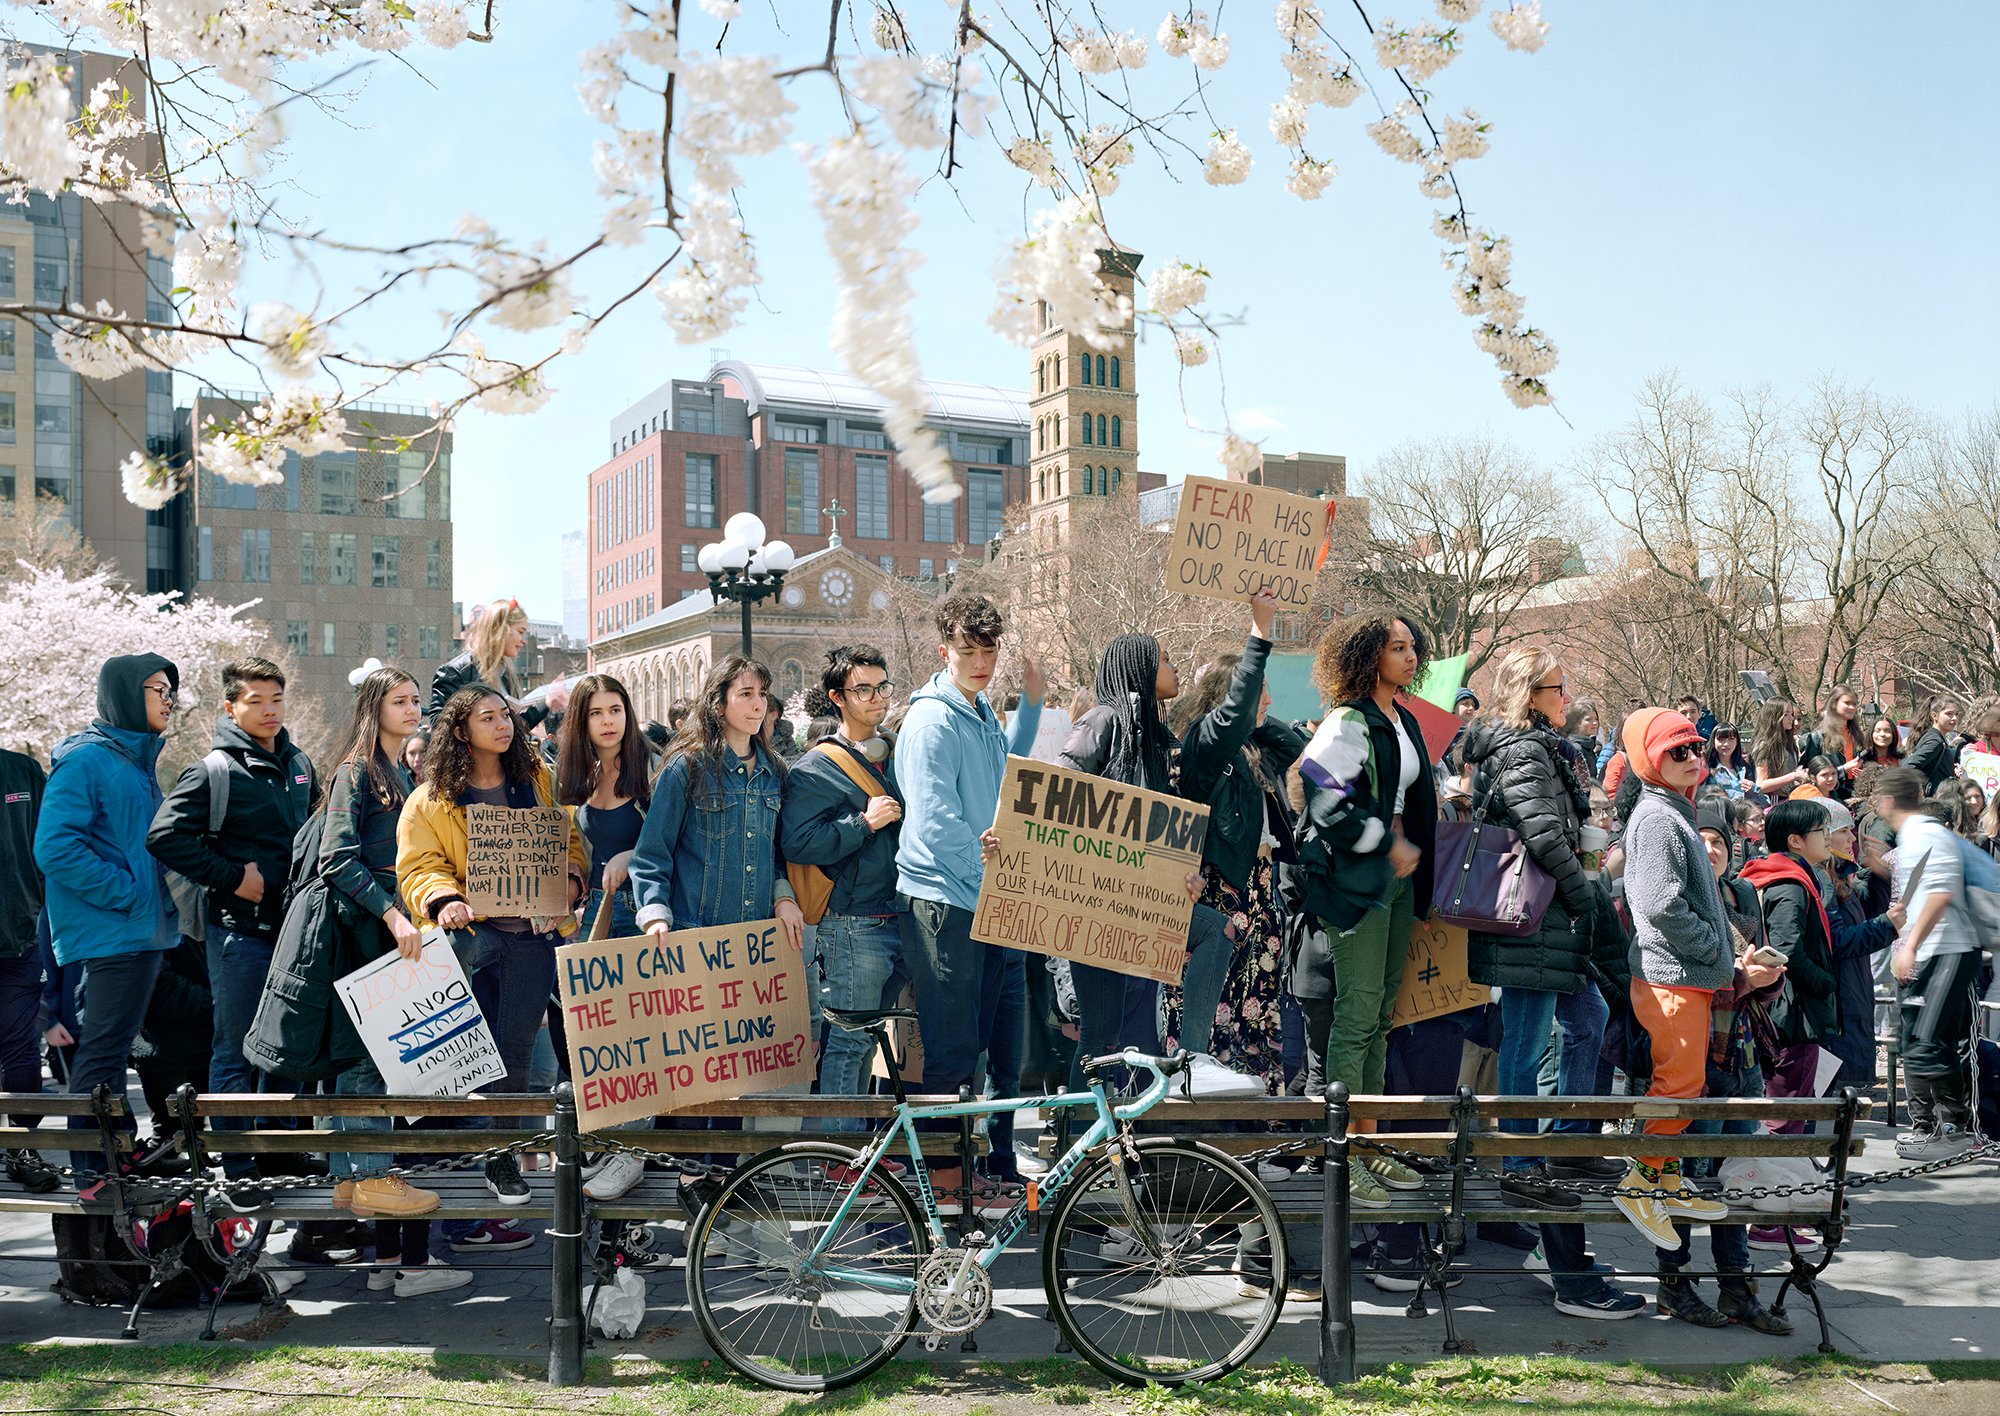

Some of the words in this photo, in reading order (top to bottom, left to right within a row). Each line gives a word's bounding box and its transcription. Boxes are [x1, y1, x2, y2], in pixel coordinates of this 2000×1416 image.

[1192, 484, 1254, 524] FEAR
[1274, 504, 1313, 536] HAS
[1187, 522, 1222, 550] NO
[1234, 531, 1289, 567] PLACE
[1295, 545, 1316, 571] IN
[1180, 558, 1223, 590] OUR
[1234, 569, 1312, 605] SCHOOLS
[472, 810, 517, 821] WHEN
[522, 811, 526, 821] I
[529, 810, 563, 822] SAID
[535, 823, 560, 836] DIE
[1013, 769, 1045, 816] I
[1043, 774, 1125, 834] HAVE
[1120, 796, 1142, 842] A
[517, 839, 529, 849] TO
[532, 837, 568, 853] MATH
[1024, 820, 1070, 848] THAT
[1073, 834, 1113, 859] ONE
[1116, 844, 1147, 869] DAY,
[468, 864, 510, 877] MEAN
[516, 865, 528, 876] IT
[531, 864, 560, 876] THIS
[999, 850, 1031, 875] WE
[1044, 855, 1086, 886] WILL
[1092, 872, 1124, 894] WALK
[1129, 882, 1186, 908] THROUGH
[995, 872, 1027, 890] OUR
[1032, 880, 1104, 908] HALLWAYS
[1106, 899, 1139, 920] AGAIN
[1141, 910, 1189, 934] WITHOUT
[978, 894, 1049, 946] FEAR
[1054, 913, 1082, 952] OF
[1084, 920, 1148, 966] BEING
[1149, 940, 1185, 975] SHOT
[566, 953, 624, 997] HOW
[637, 945, 685, 980] CAN
[698, 939, 735, 972] WE
[746, 926, 777, 966] BE
[569, 998, 617, 1032] THE
[628, 984, 705, 1019] FUTURE
[718, 980, 743, 1010] IF
[752, 973, 788, 1005] WE
[395, 1003, 475, 1054] GUNS
[417, 1027, 486, 1077] WITHOUT
[579, 1036, 651, 1078] DON'T
[662, 1022, 719, 1057] LIVE
[724, 1015, 776, 1046] LONG
[449, 1042, 497, 1071] PEOPLE
[454, 1059, 503, 1093] FUNNY
[582, 1071, 658, 1112] ENOUGH
[664, 1064, 694, 1091] TO
[704, 1051, 739, 1084] GET
[742, 1033, 806, 1077] THERE?
[915, 1159, 938, 1219] Bianchi
